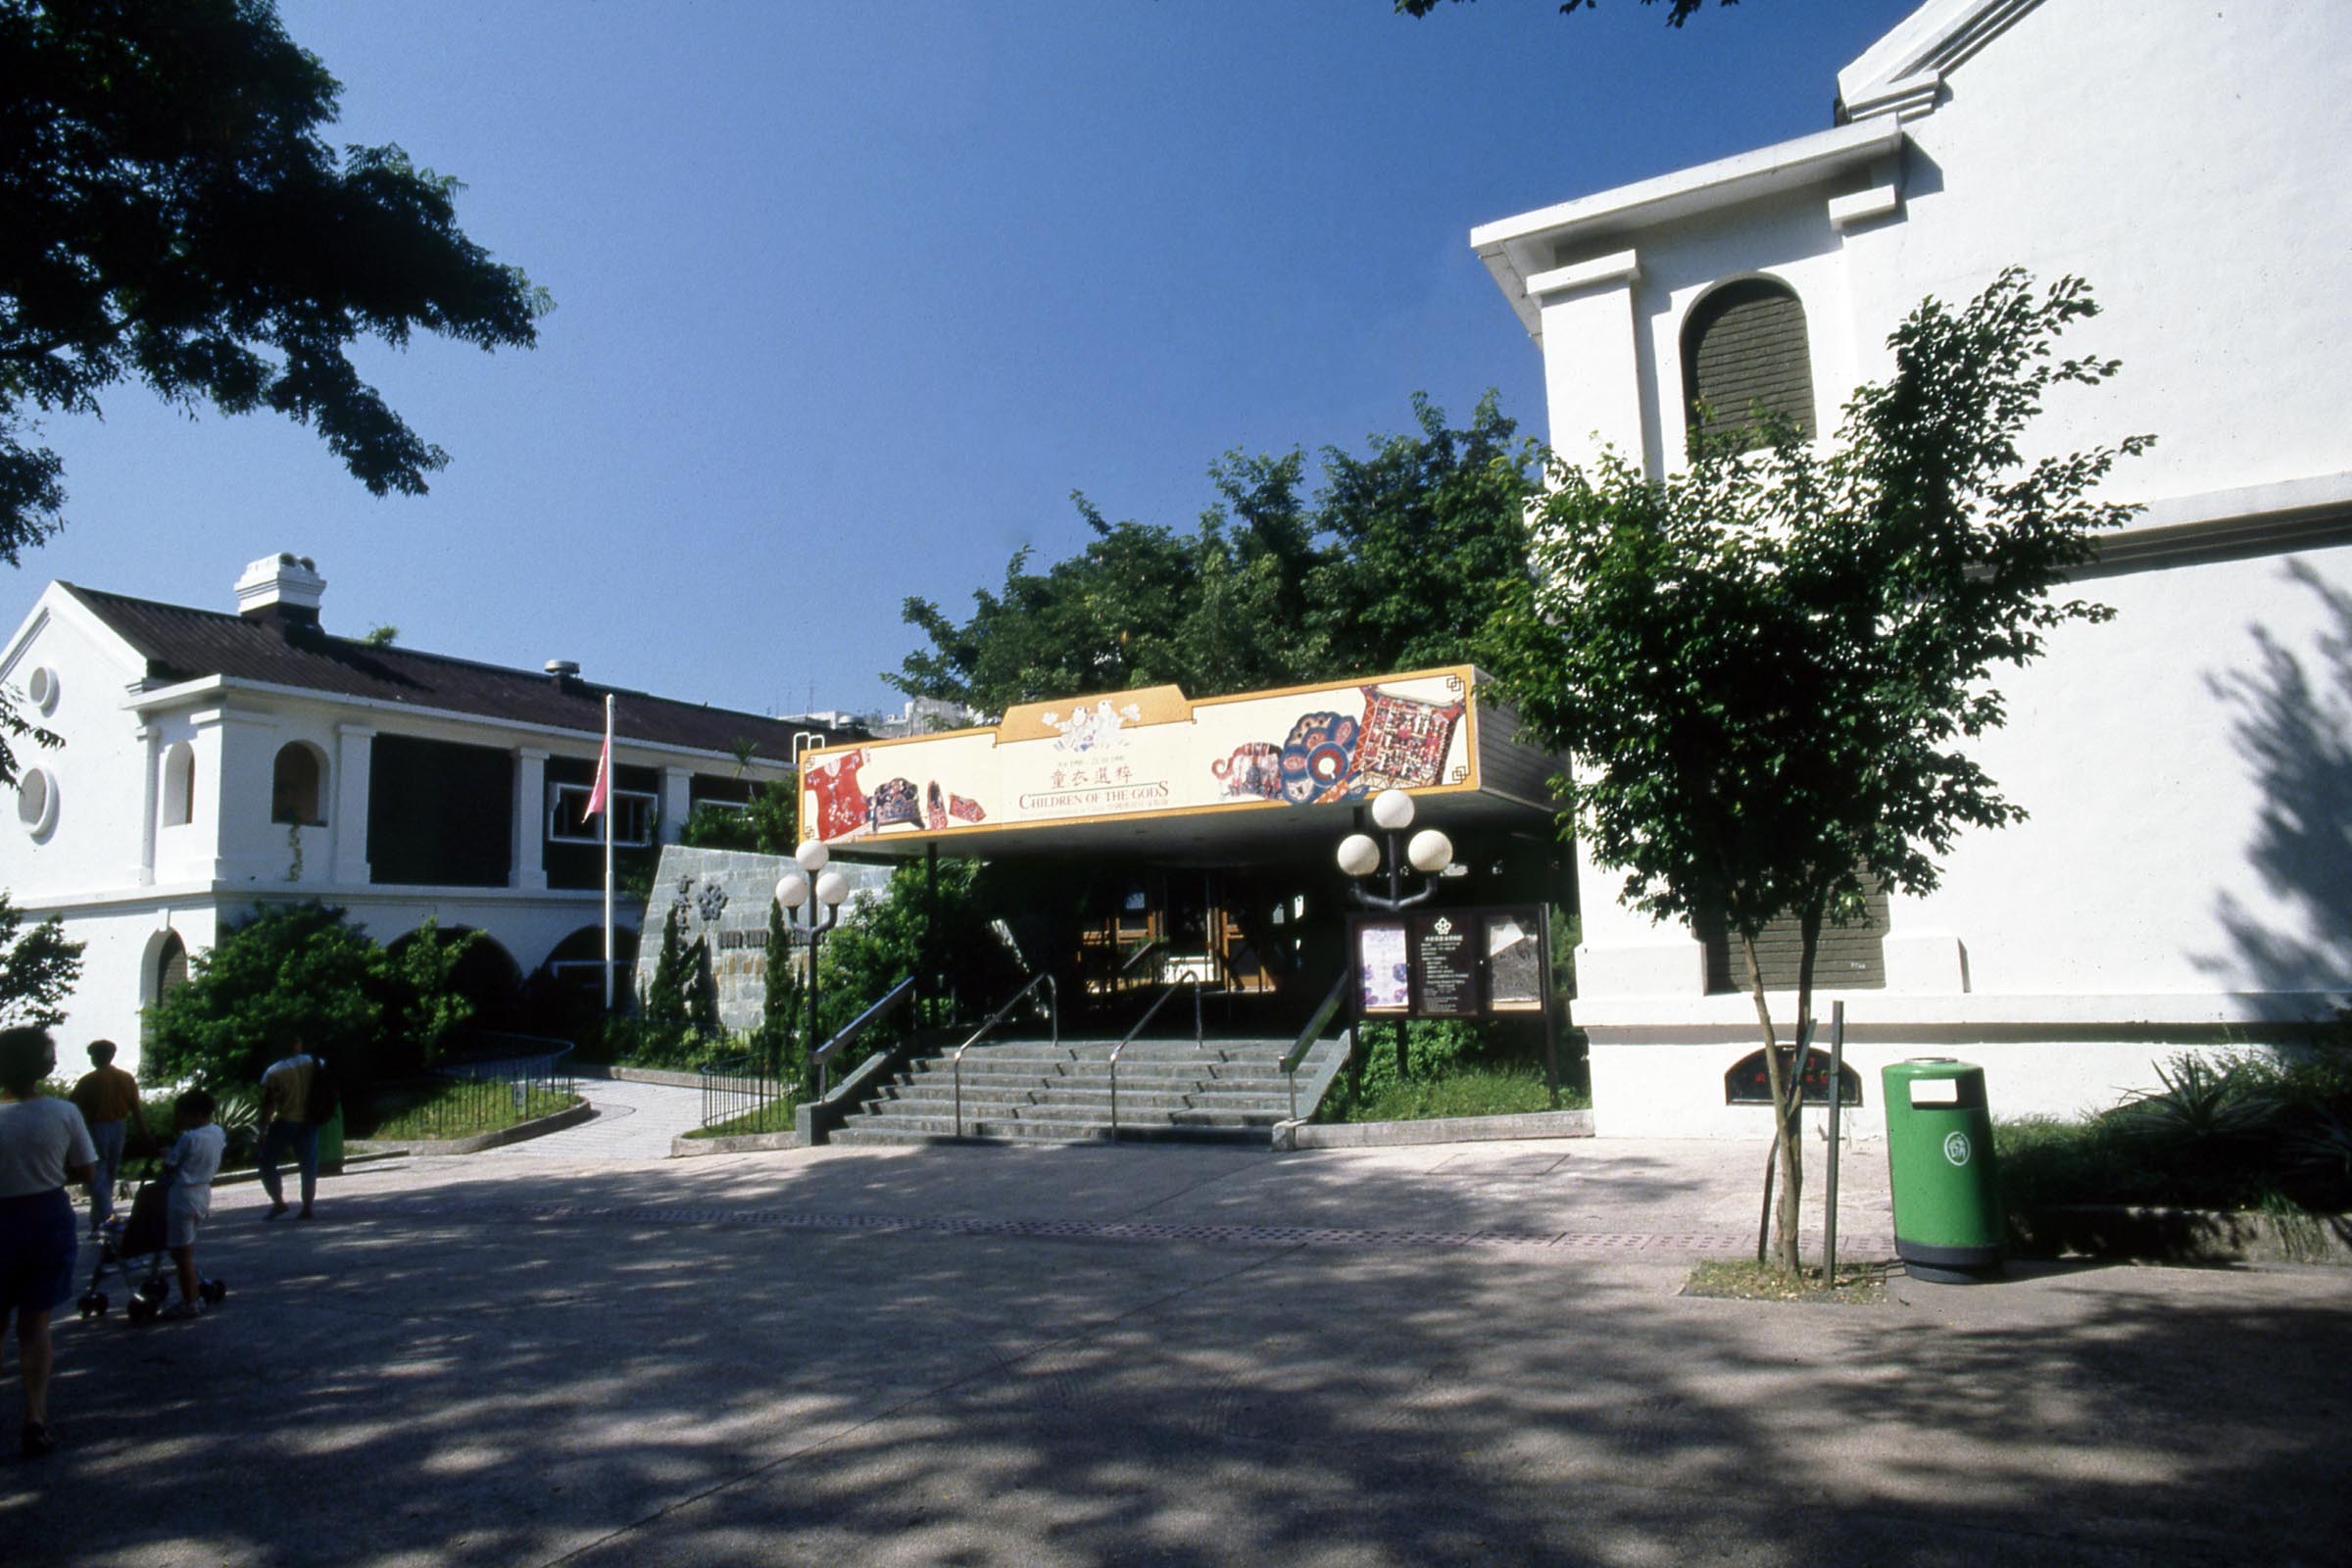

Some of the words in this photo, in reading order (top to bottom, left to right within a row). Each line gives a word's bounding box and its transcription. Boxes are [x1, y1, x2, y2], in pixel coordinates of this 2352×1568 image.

[1019, 792, 1083, 809] CHILDREN
[1085, 792, 1099, 804] OF
[1105, 790, 1129, 802] THE
[1132, 780, 1169, 800] GODS
